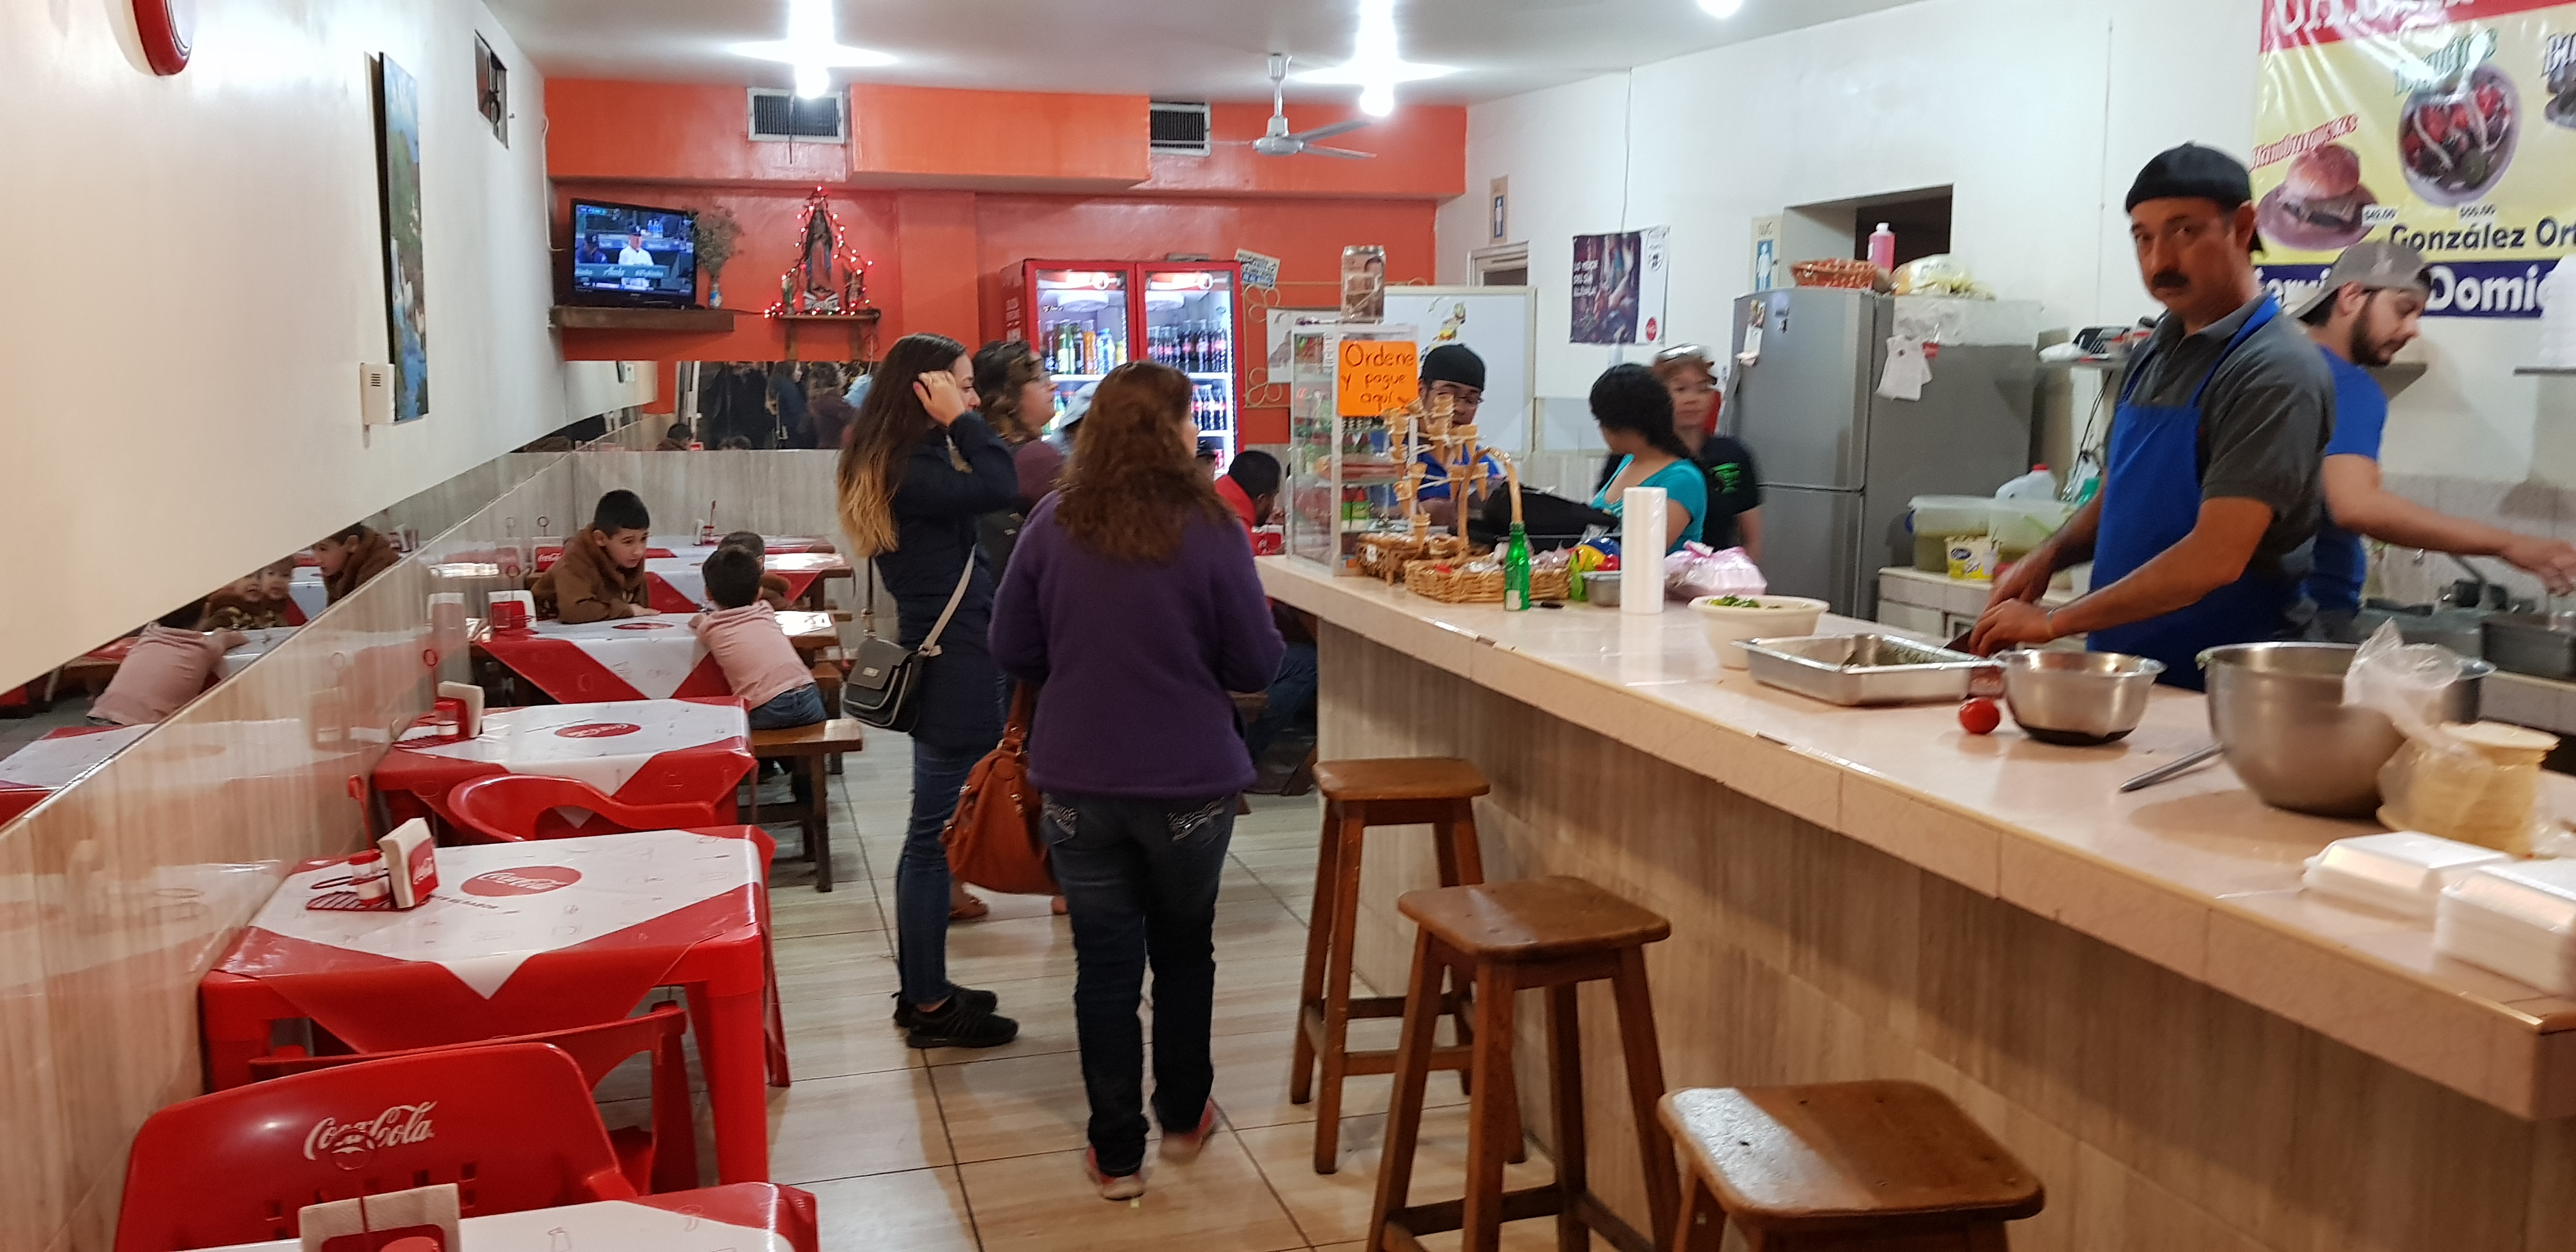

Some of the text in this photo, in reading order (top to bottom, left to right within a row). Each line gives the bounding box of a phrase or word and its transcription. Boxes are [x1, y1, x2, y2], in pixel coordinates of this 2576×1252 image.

[2389, 222, 2526, 252] González
[1345, 343, 1415, 368] Ordene
[1365, 372, 1406, 391] pague
